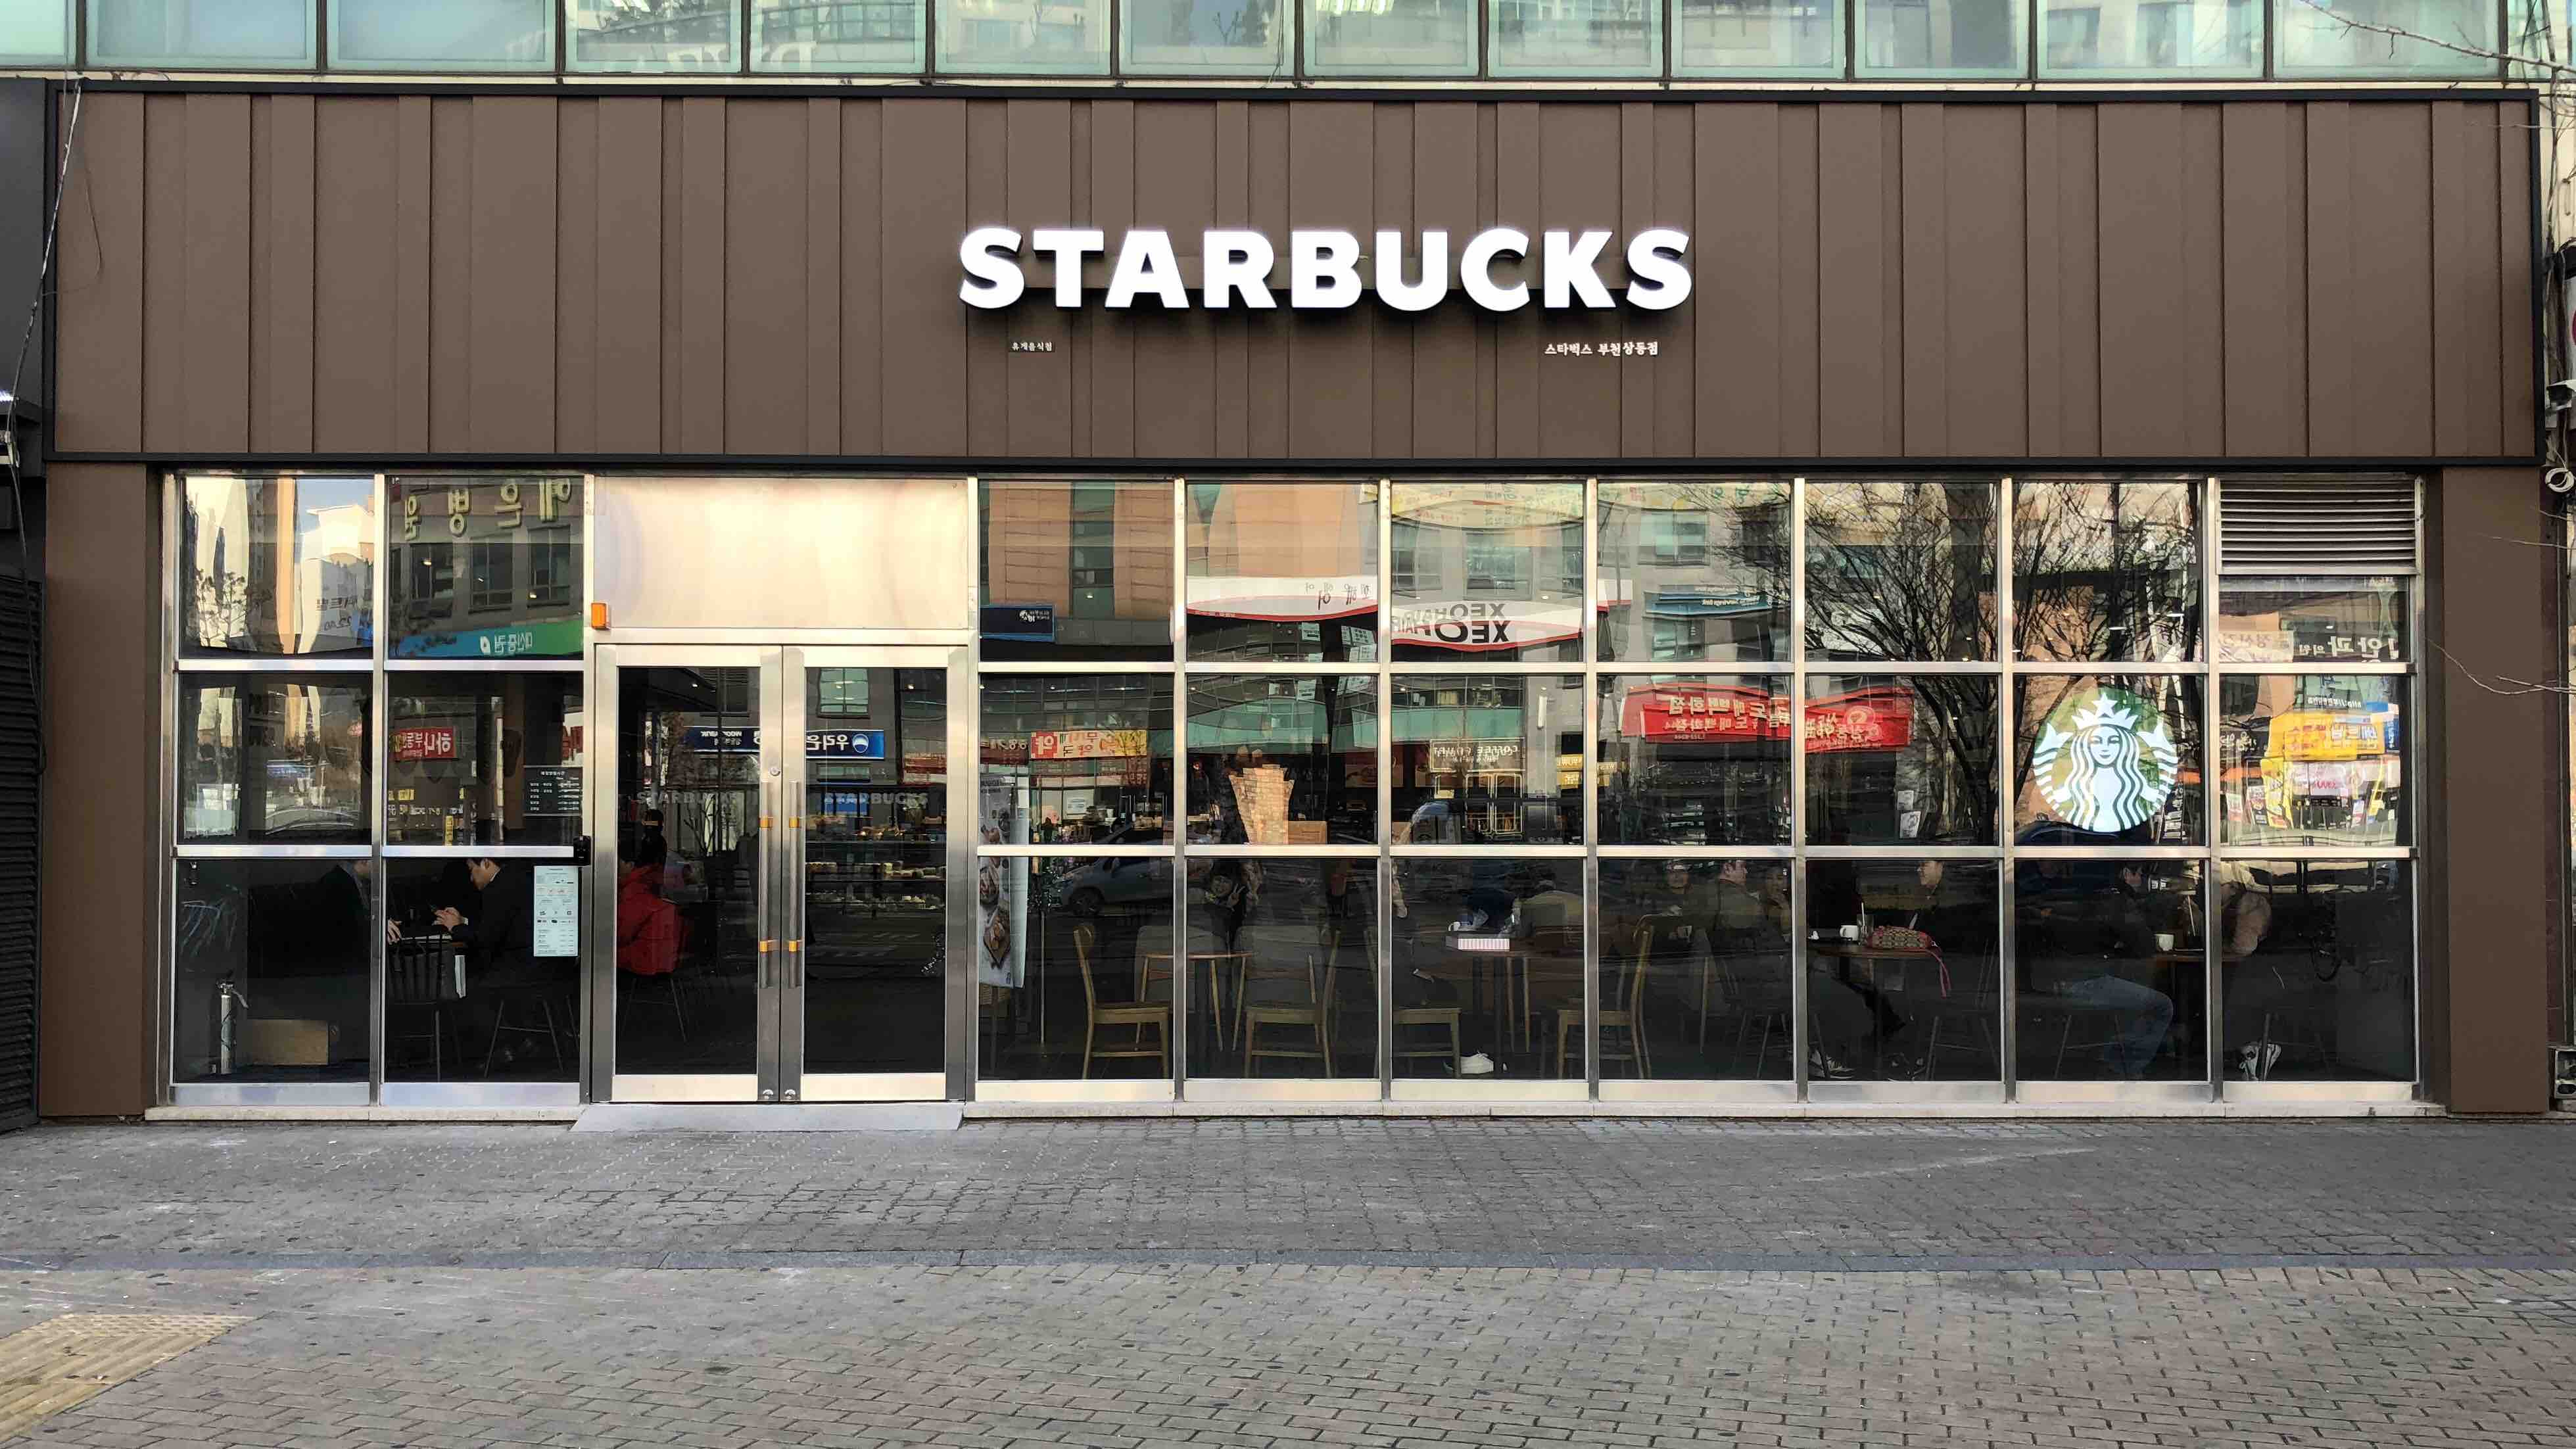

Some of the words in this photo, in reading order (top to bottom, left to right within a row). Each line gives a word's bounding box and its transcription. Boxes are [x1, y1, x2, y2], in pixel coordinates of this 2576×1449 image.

[959, 226, 1693, 312] STARBUCKS
[1012, 341, 1052, 352] 휴게음식점
[1544, 342, 1593, 356] 스타벅스
[1597, 341, 1658, 356] 부천상동점
